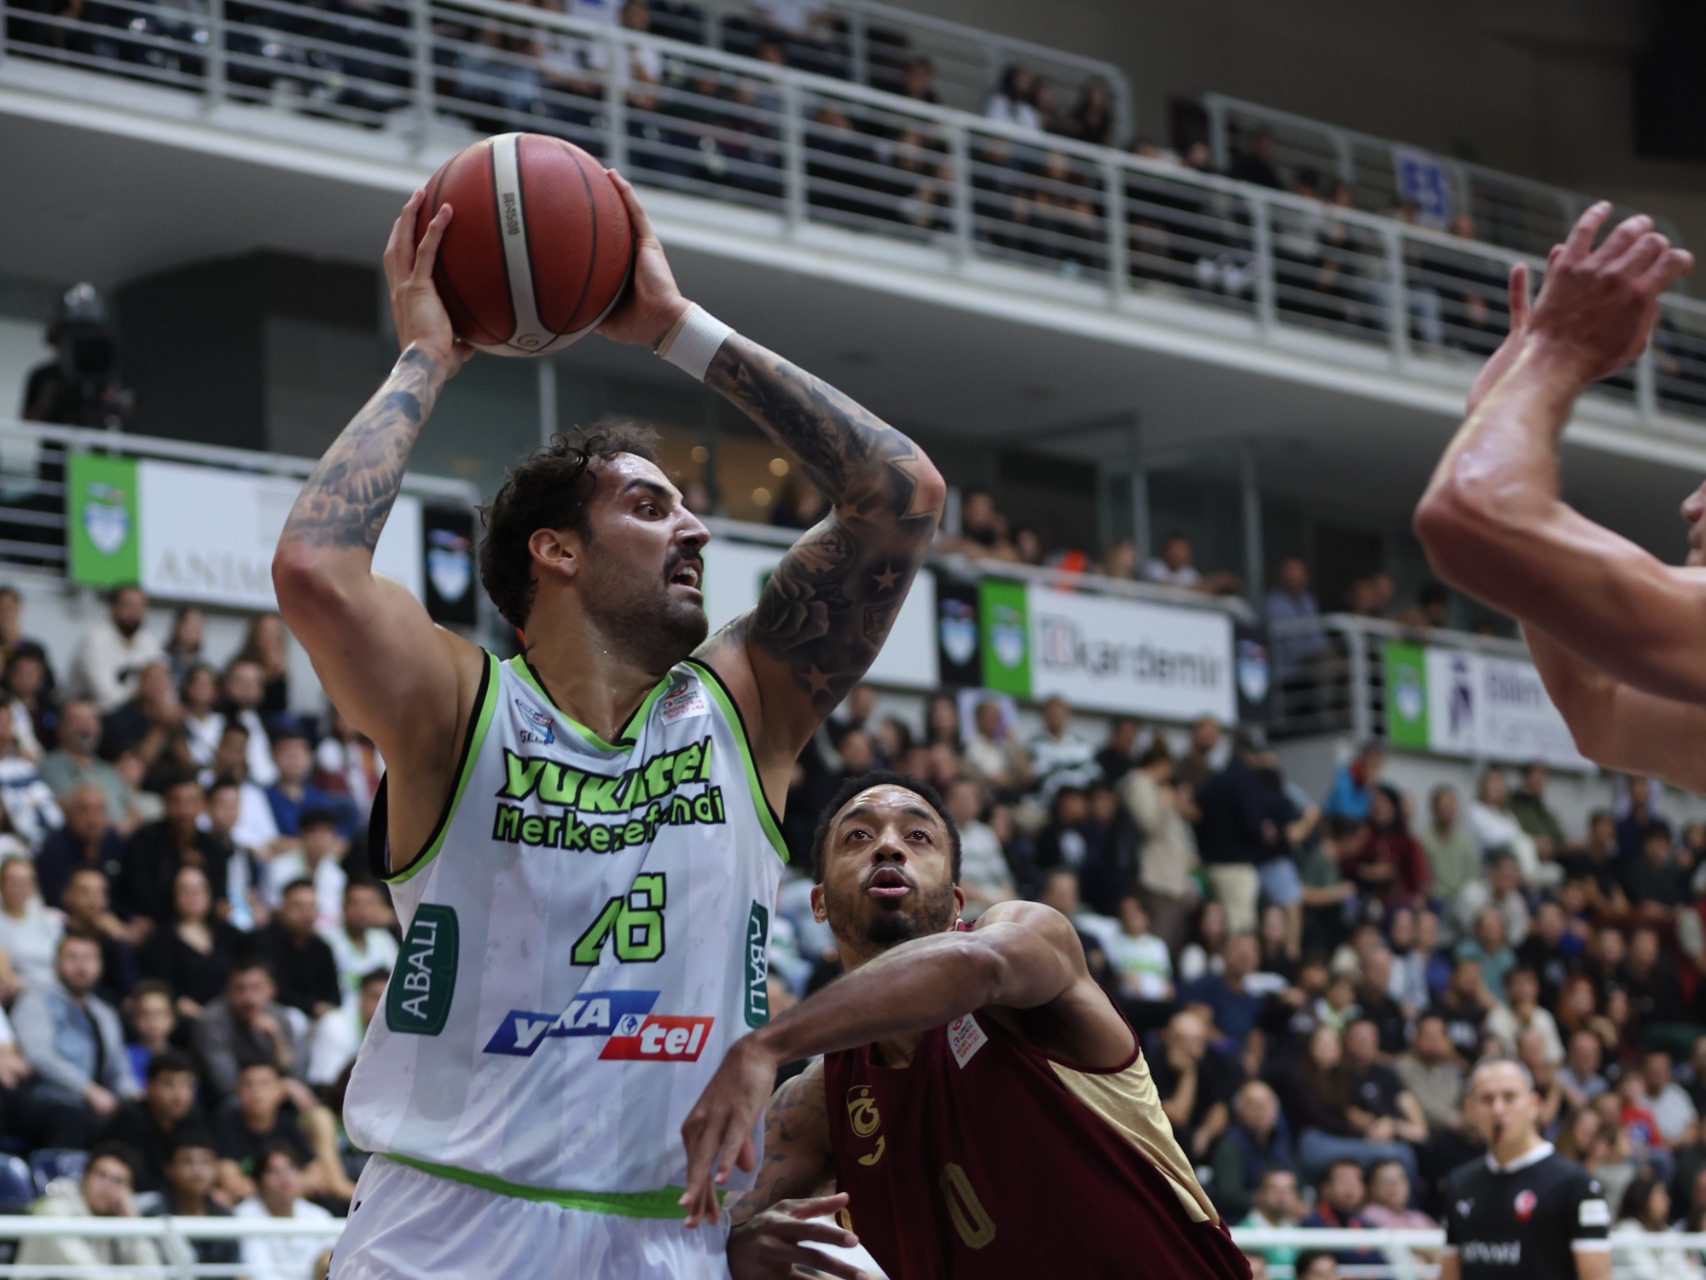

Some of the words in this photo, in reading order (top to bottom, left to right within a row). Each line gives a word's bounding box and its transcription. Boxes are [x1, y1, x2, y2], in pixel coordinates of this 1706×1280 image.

[401, 920, 438, 1020] ABALI
[750, 915, 767, 1016] ABALI
[939, 1162, 996, 1249] 0
